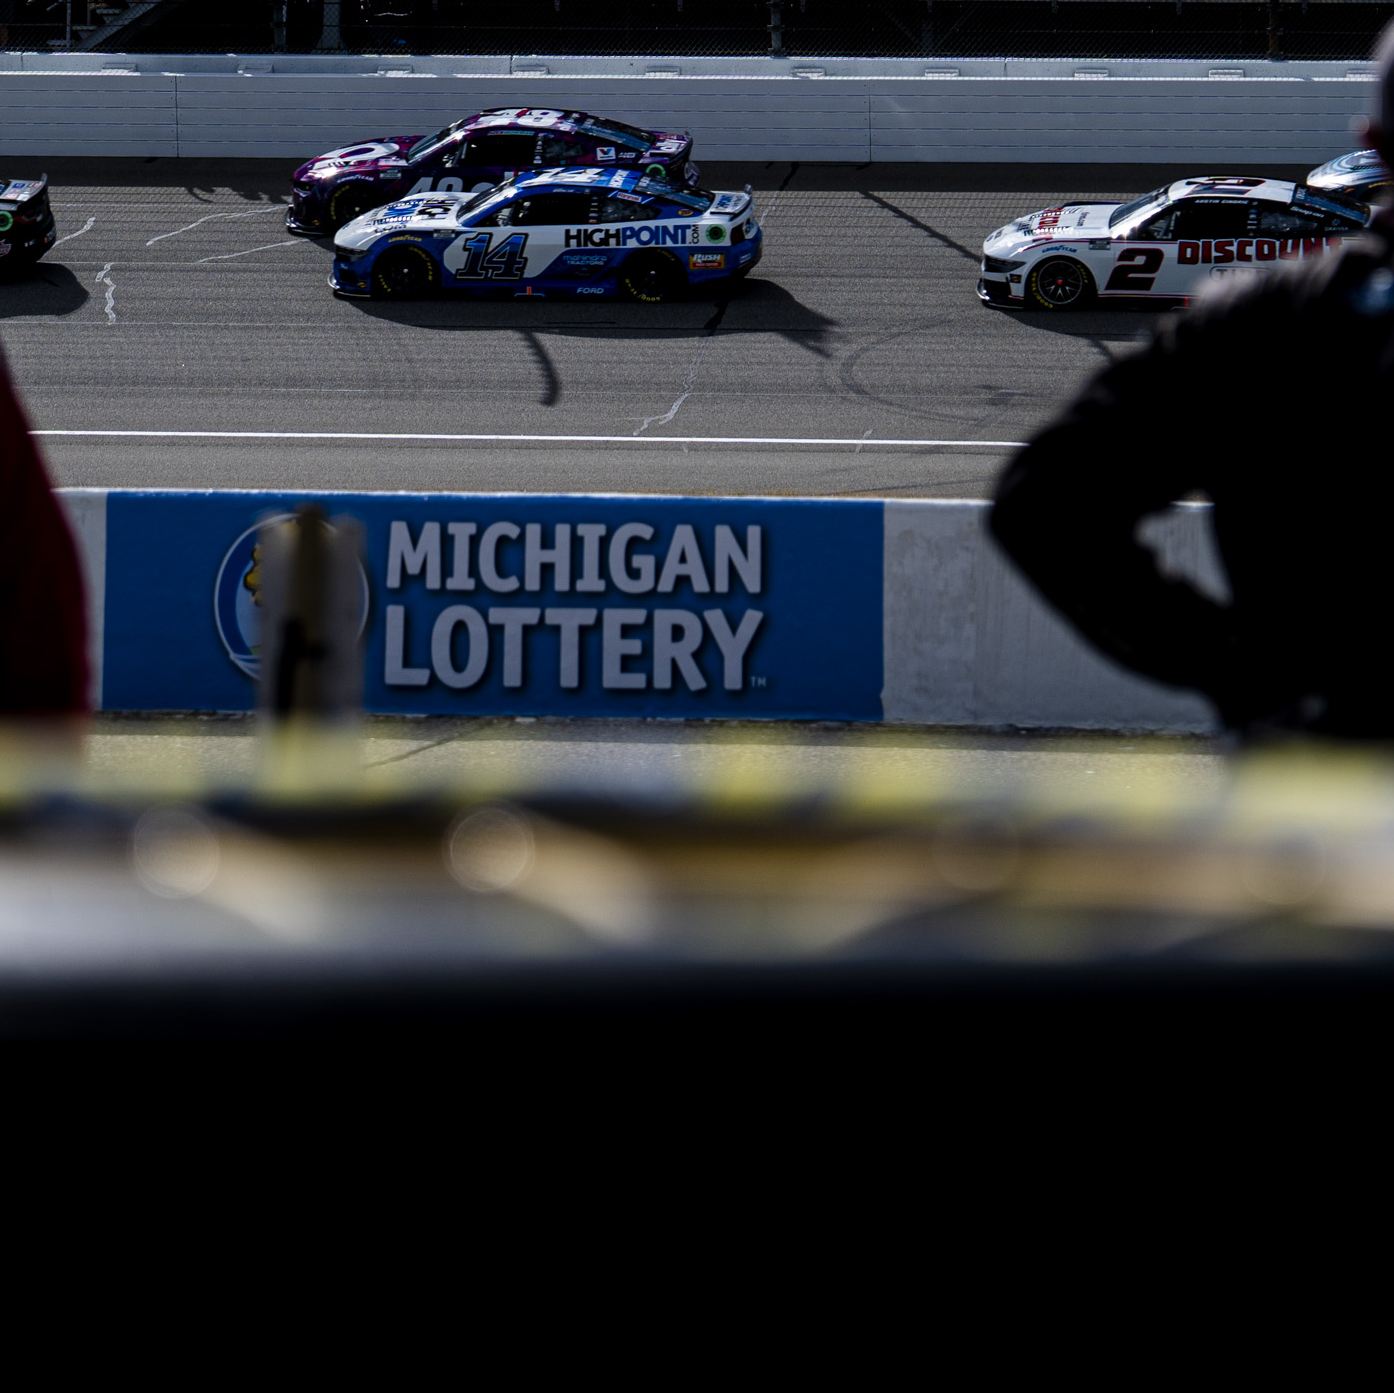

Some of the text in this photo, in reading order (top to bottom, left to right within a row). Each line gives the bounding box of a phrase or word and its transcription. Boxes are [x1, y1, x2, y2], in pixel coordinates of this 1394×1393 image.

[455, 232, 529, 281] 14
[564, 224, 691, 248] HIGHPOINT
[576, 286, 605, 295] FORD
[1104, 247, 1165, 291] 2
[384, 519, 764, 597] MICHIGAN
[383, 603, 764, 693] LOTTERY
